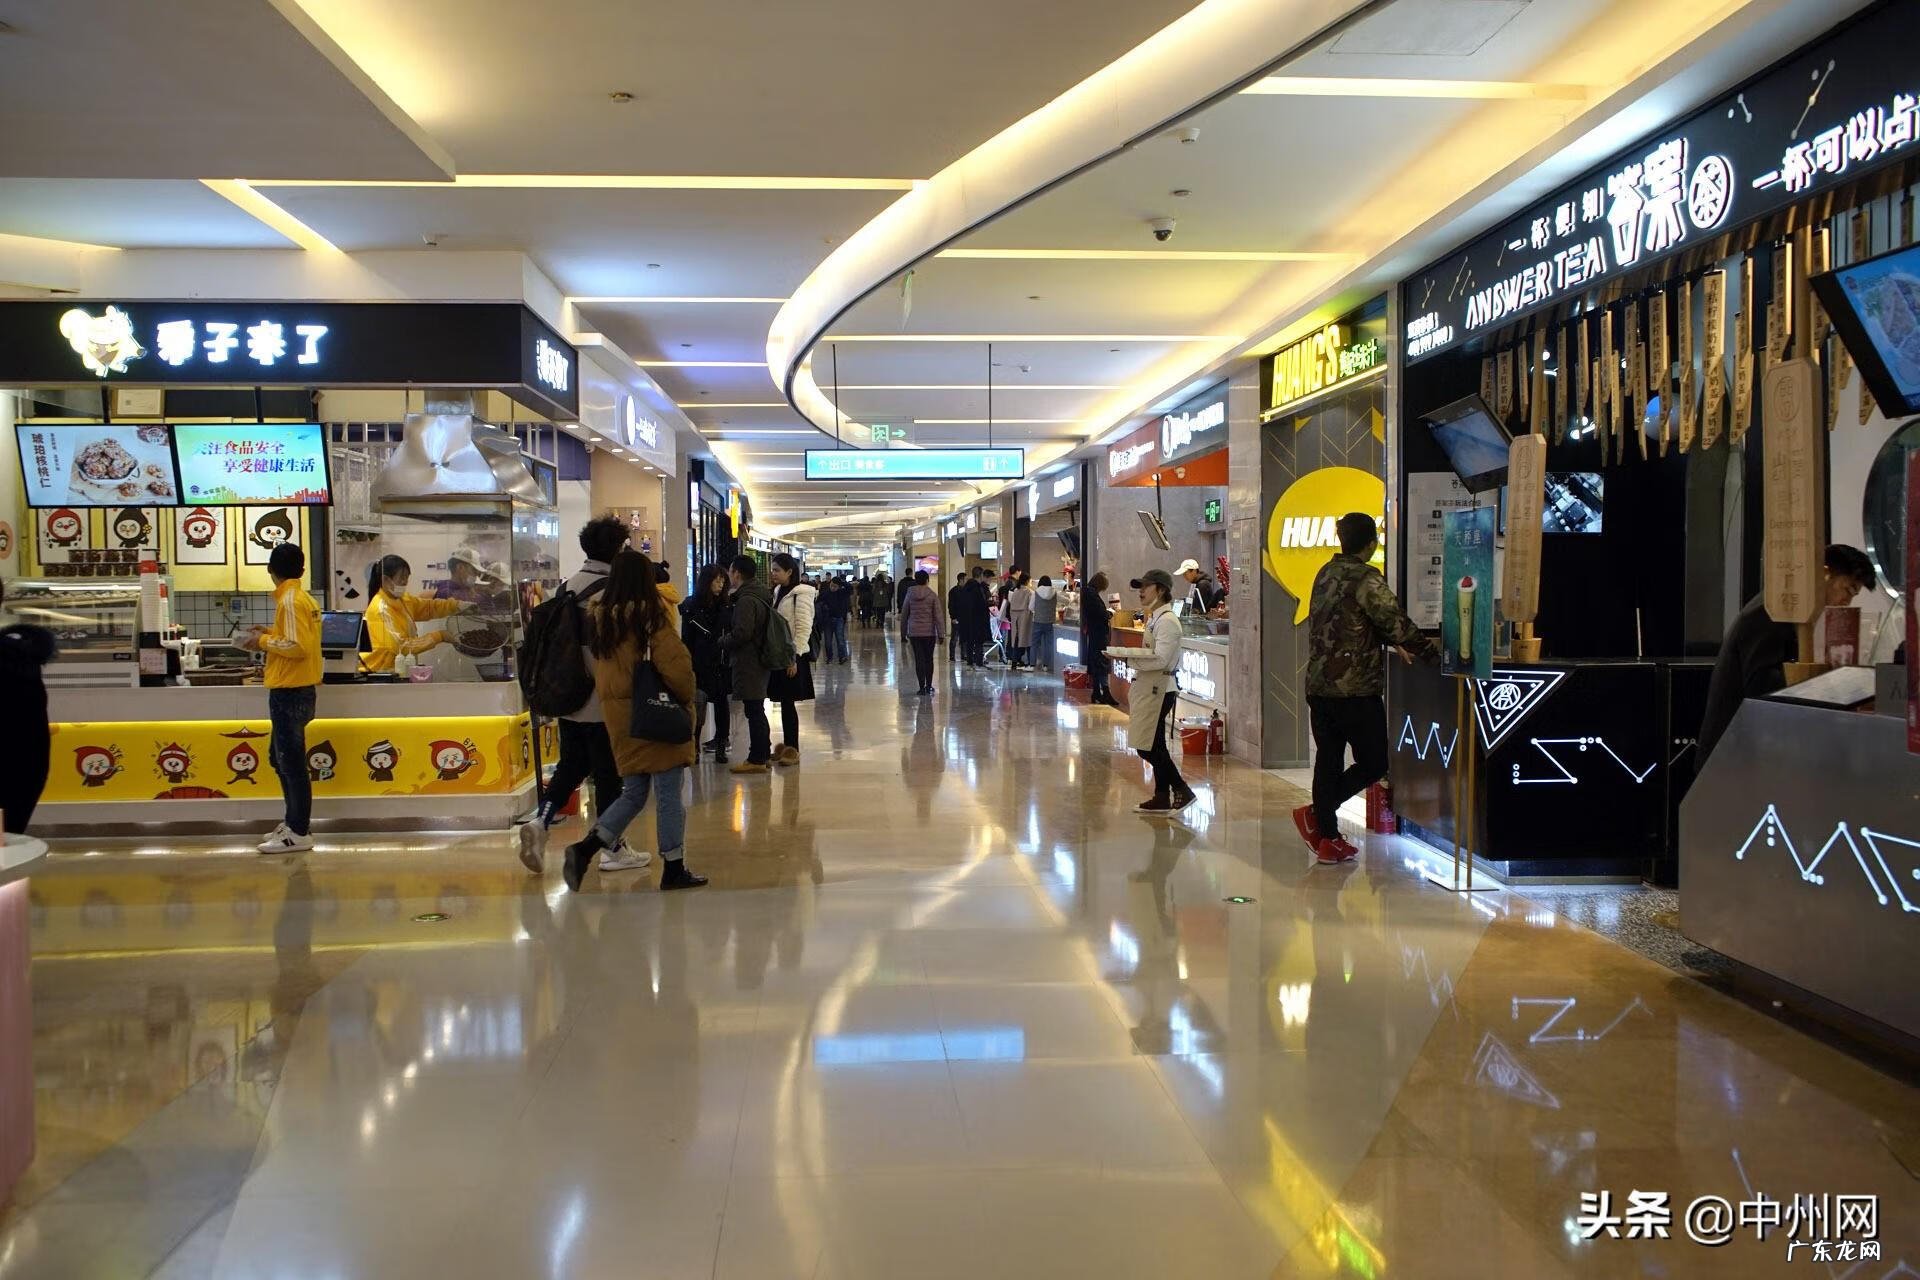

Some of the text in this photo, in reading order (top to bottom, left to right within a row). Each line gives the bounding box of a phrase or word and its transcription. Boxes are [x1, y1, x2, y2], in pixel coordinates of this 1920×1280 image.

[1465, 261, 1553, 331] ANSWER
[1553, 236, 1606, 291] TEA
[1271, 323, 1341, 409] HUANG'S
[223, 457, 316, 473] 享受健康生活
